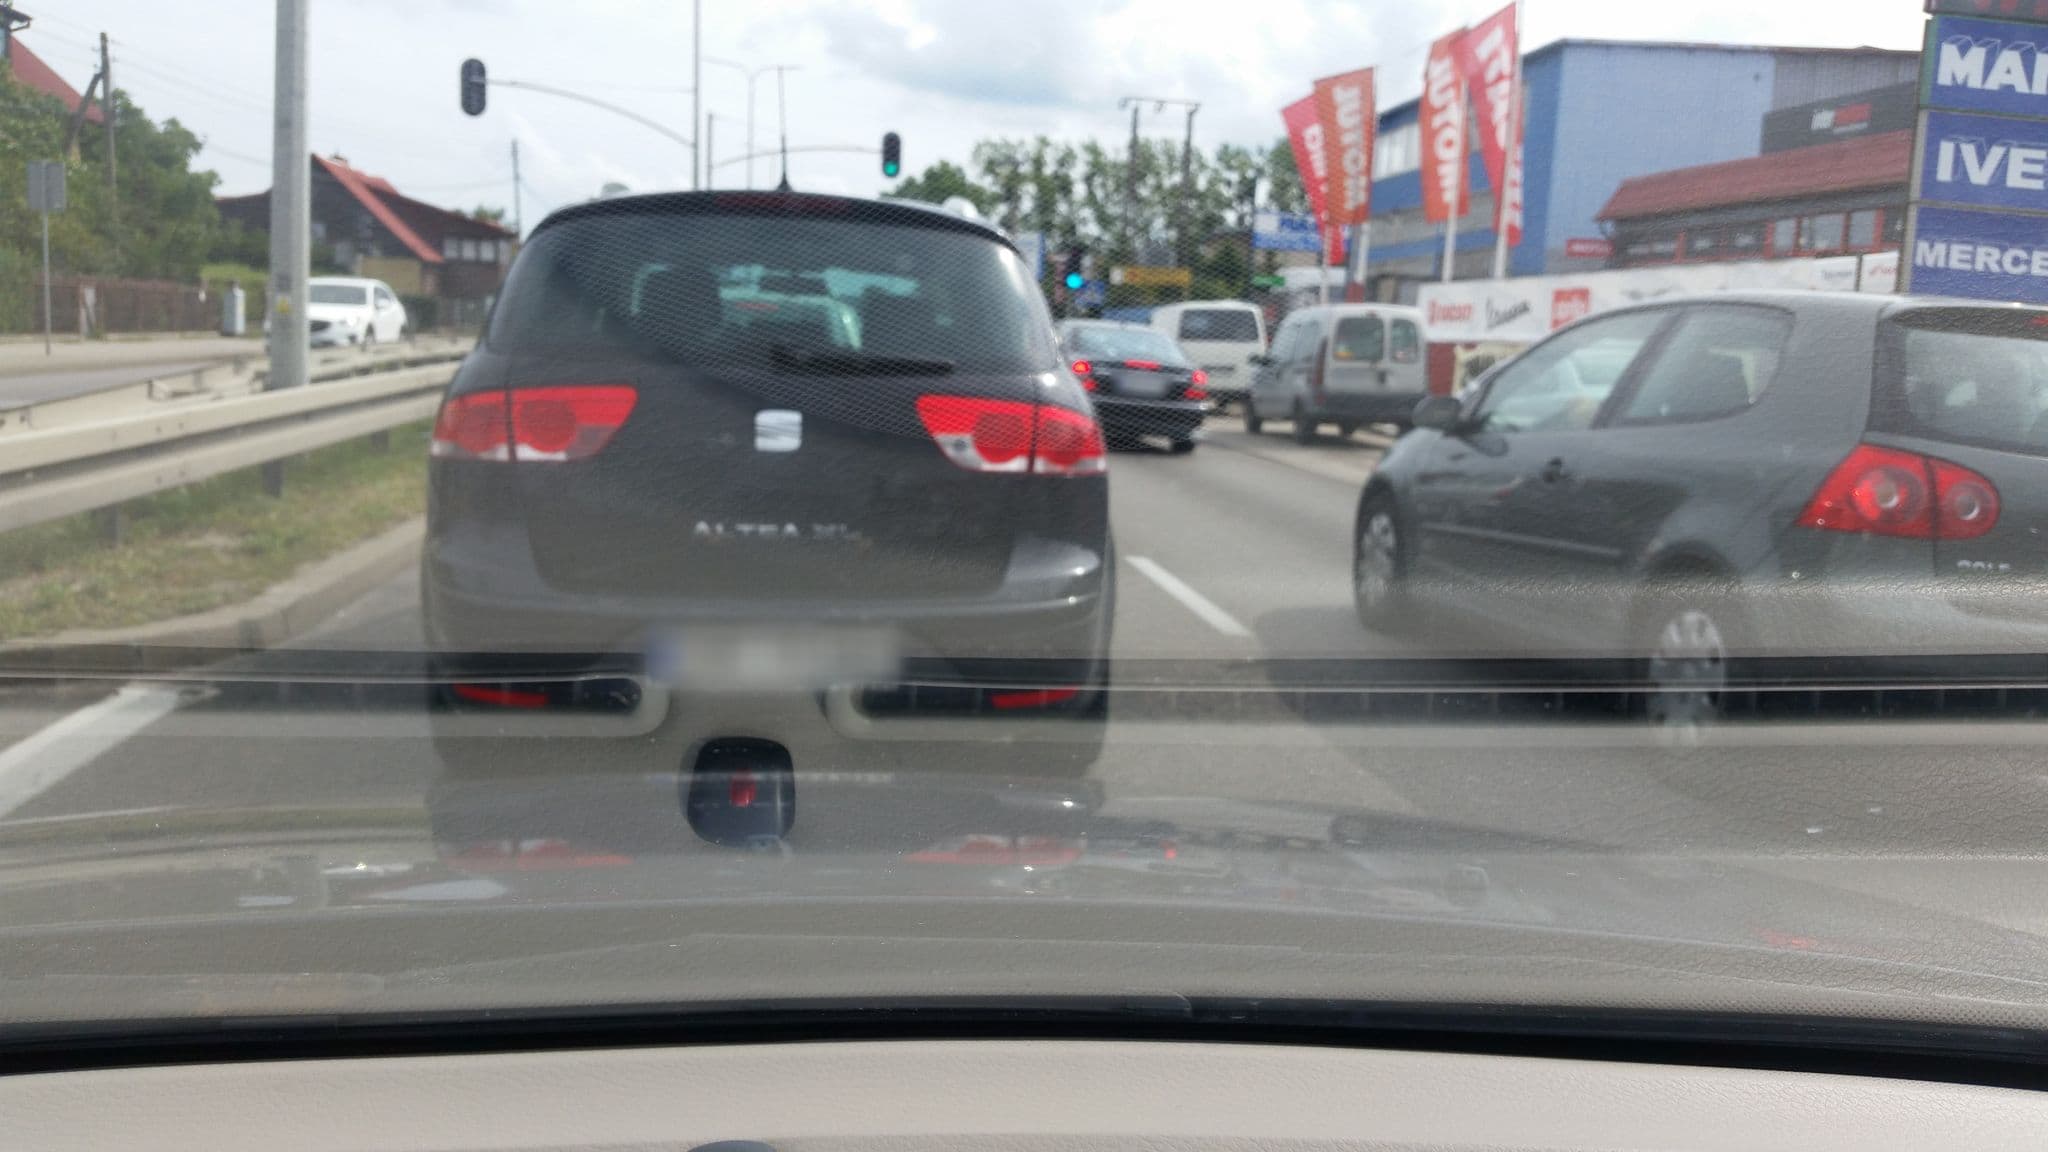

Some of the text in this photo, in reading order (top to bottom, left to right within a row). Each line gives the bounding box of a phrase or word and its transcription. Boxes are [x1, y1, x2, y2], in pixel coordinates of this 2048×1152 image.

[1936, 141, 2047, 190] IVE
[1915, 241, 2048, 277] MERCE
[694, 520, 799, 539] ALTEA
